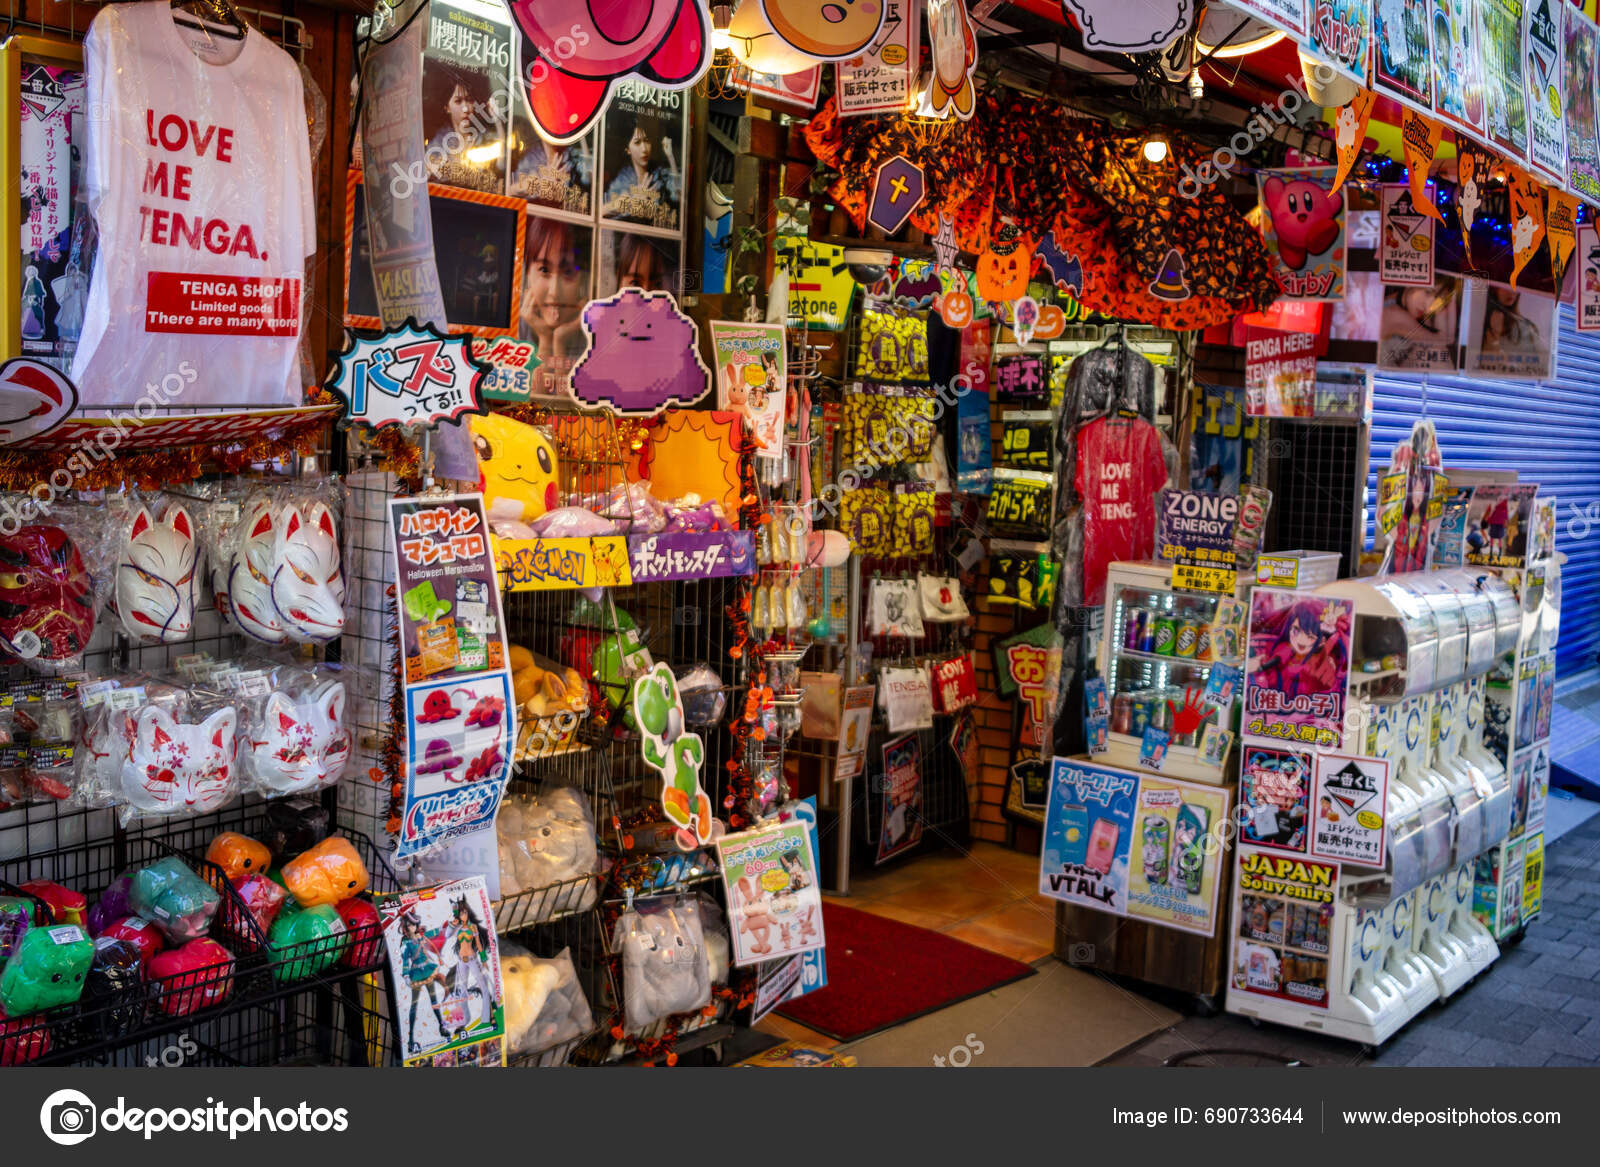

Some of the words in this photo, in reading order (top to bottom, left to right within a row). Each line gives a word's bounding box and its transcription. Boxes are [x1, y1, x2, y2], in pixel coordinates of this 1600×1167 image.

[1313, 2, 1361, 65] Kirby
[147, 109, 234, 163] LOVE
[142, 158, 193, 201] ME
[139, 206, 269, 262] TENGA.
[180, 280, 238, 298] TENGA
[243, 284, 283, 299] SHOP
[148, 311, 194, 325] There
[198, 315, 223, 326] are
[227, 316, 264, 330] many
[267, 317, 297, 329] more
[190, 301, 236, 313] Limited
[238, 302, 273, 316] goods
[1247, 338, 1281, 360] TENGA
[1283, 333, 1314, 354] HERE!
[351, 339, 455, 415] バズ
[403, 388, 463, 416] ってる!!
[1100, 462, 1131, 479] LOVE
[1101, 482, 1119, 500] ME
[400, 508, 480, 536] ハロウィン
[1173, 517, 1227, 535] ENERGY
[401, 534, 485, 566] マシュマロ
[632, 535, 726, 578] ポケットモンスター
[408, 567, 444, 580] Halloween
[1249, 685, 1341, 720] 【推しの子】
[1248, 718, 1340, 747] グッズ入荷中!
[1058, 766, 1135, 797] スパークリング
[1075, 783, 1114, 808] ソーダ
[1327, 773, 1377, 791] 一番くじ
[725, 834, 804, 868] うさぎぬいぐるみ
[1318, 832, 1378, 853] 販売中です!
[744, 859, 778, 877] 60cm
[1242, 854, 1333, 887] JAPAN
[1049, 873, 1116, 908] VTALK
[1240, 872, 1334, 905] Souvenirs
